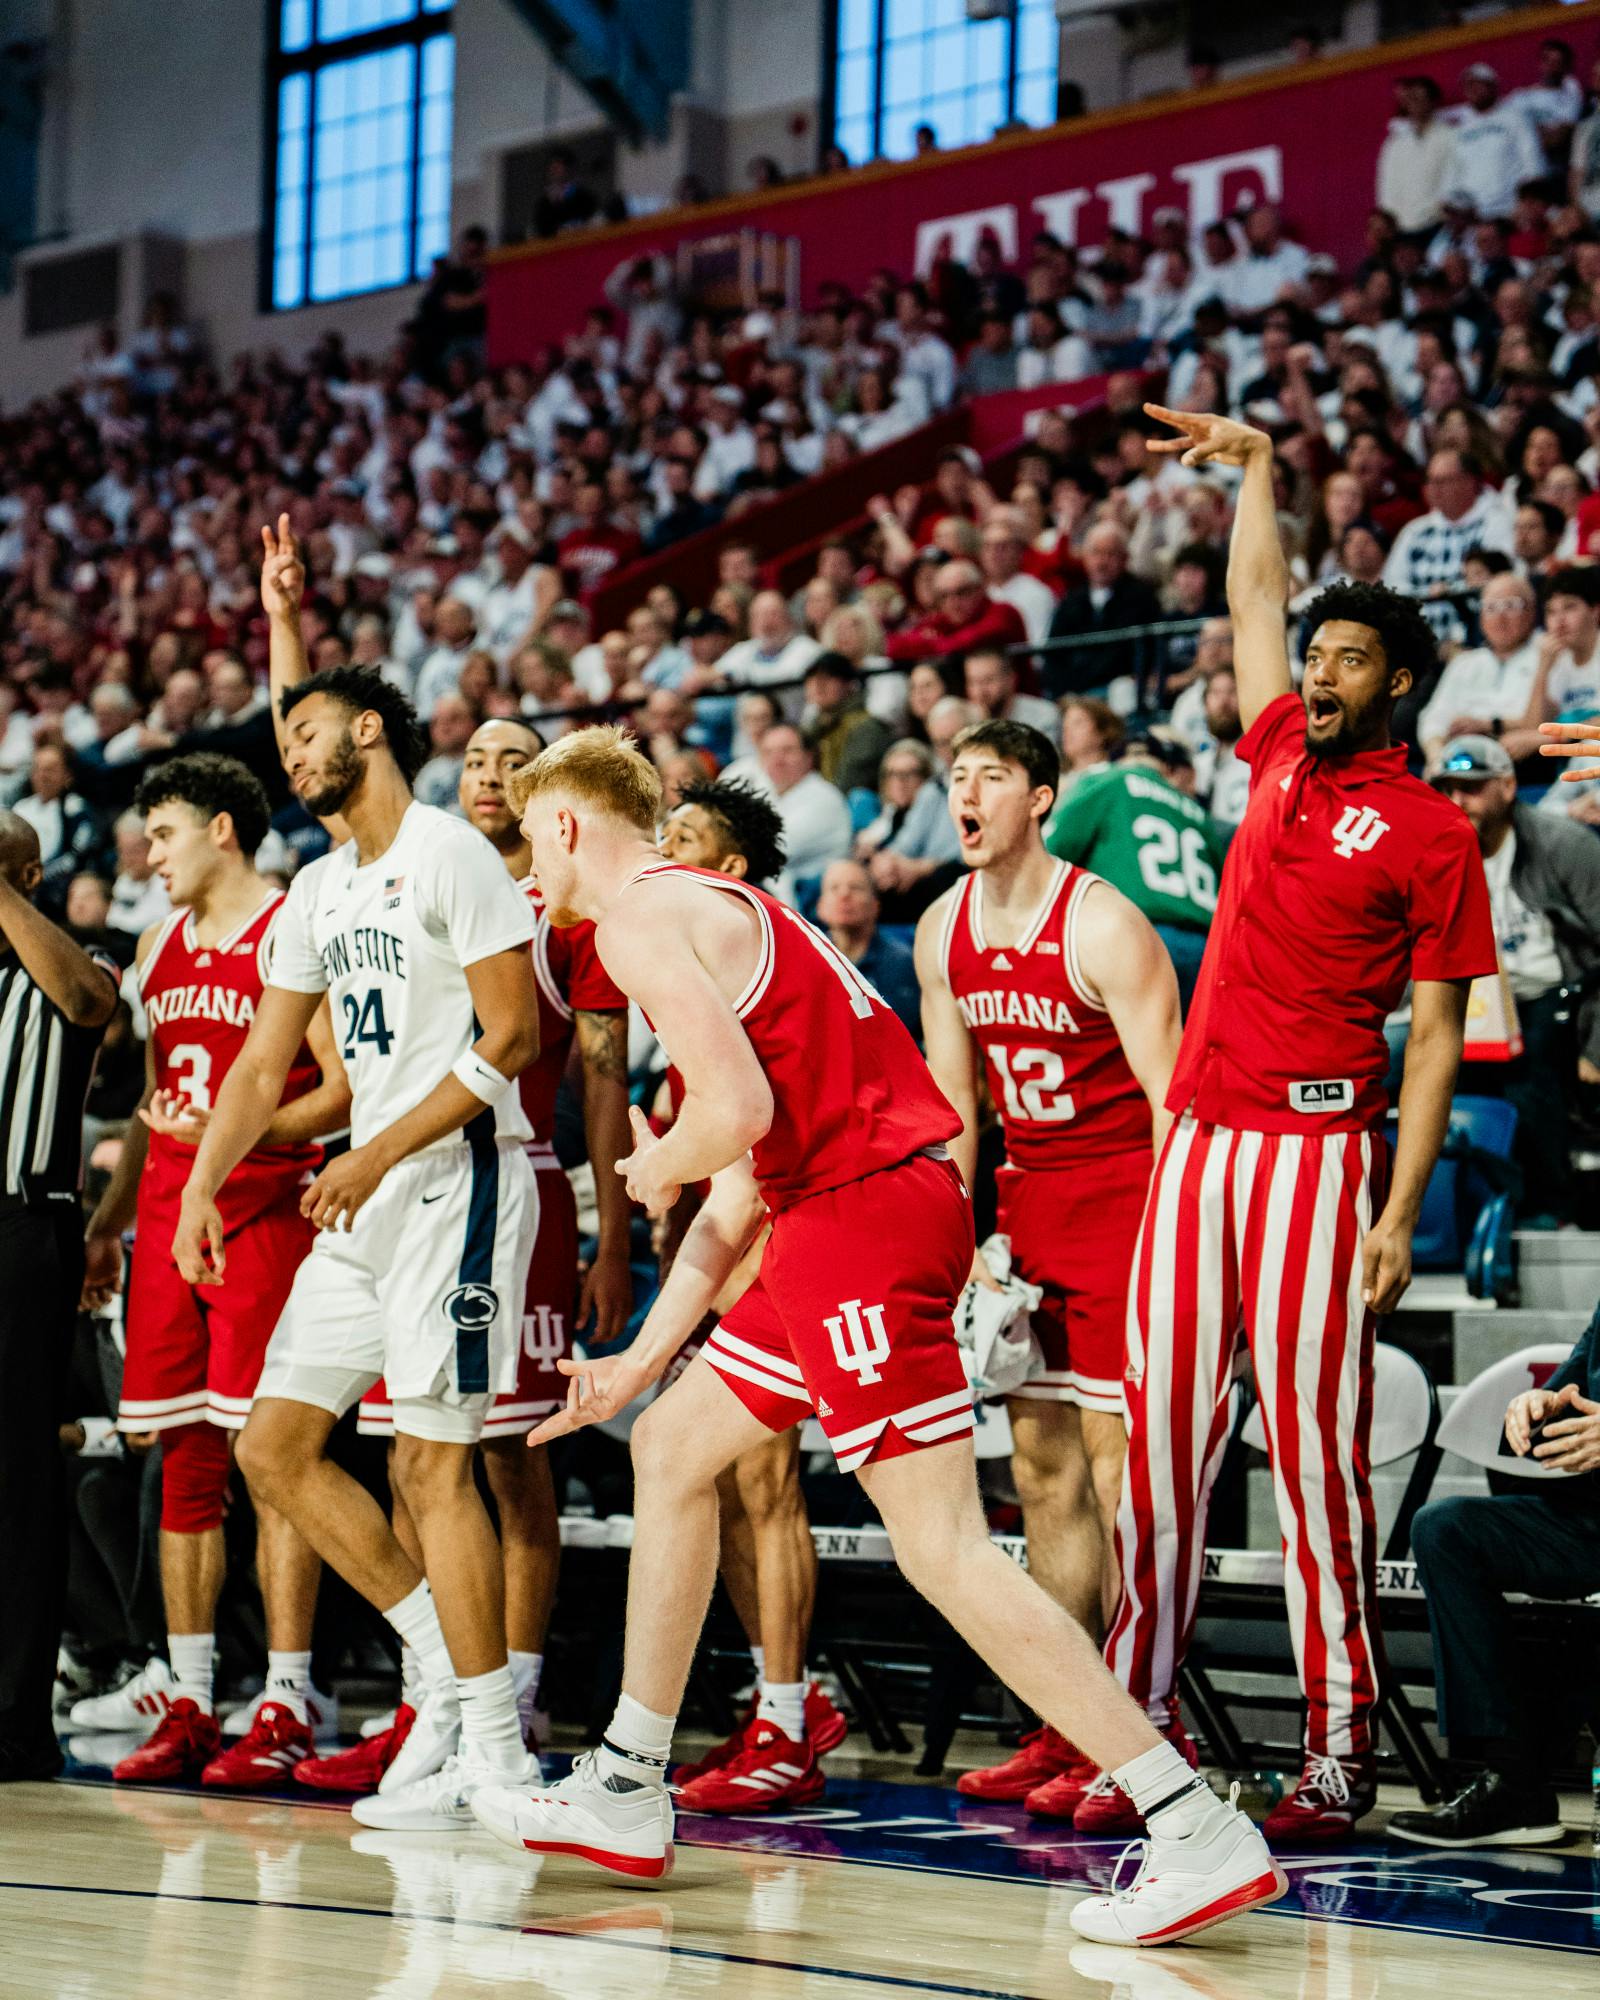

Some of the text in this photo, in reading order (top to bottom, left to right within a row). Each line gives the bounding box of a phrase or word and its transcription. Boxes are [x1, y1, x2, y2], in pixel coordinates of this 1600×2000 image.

[1132, 813, 1217, 912] 26
[320, 927, 406, 988] ENN STATE
[144, 984, 255, 1032] NDIANA
[343, 988, 395, 1060] 24
[957, 990, 1080, 1034] NDIANA
[168, 1043, 212, 1121] 3
[987, 1044, 1076, 1121] 12
[814, 1534, 862, 1554] ENN
